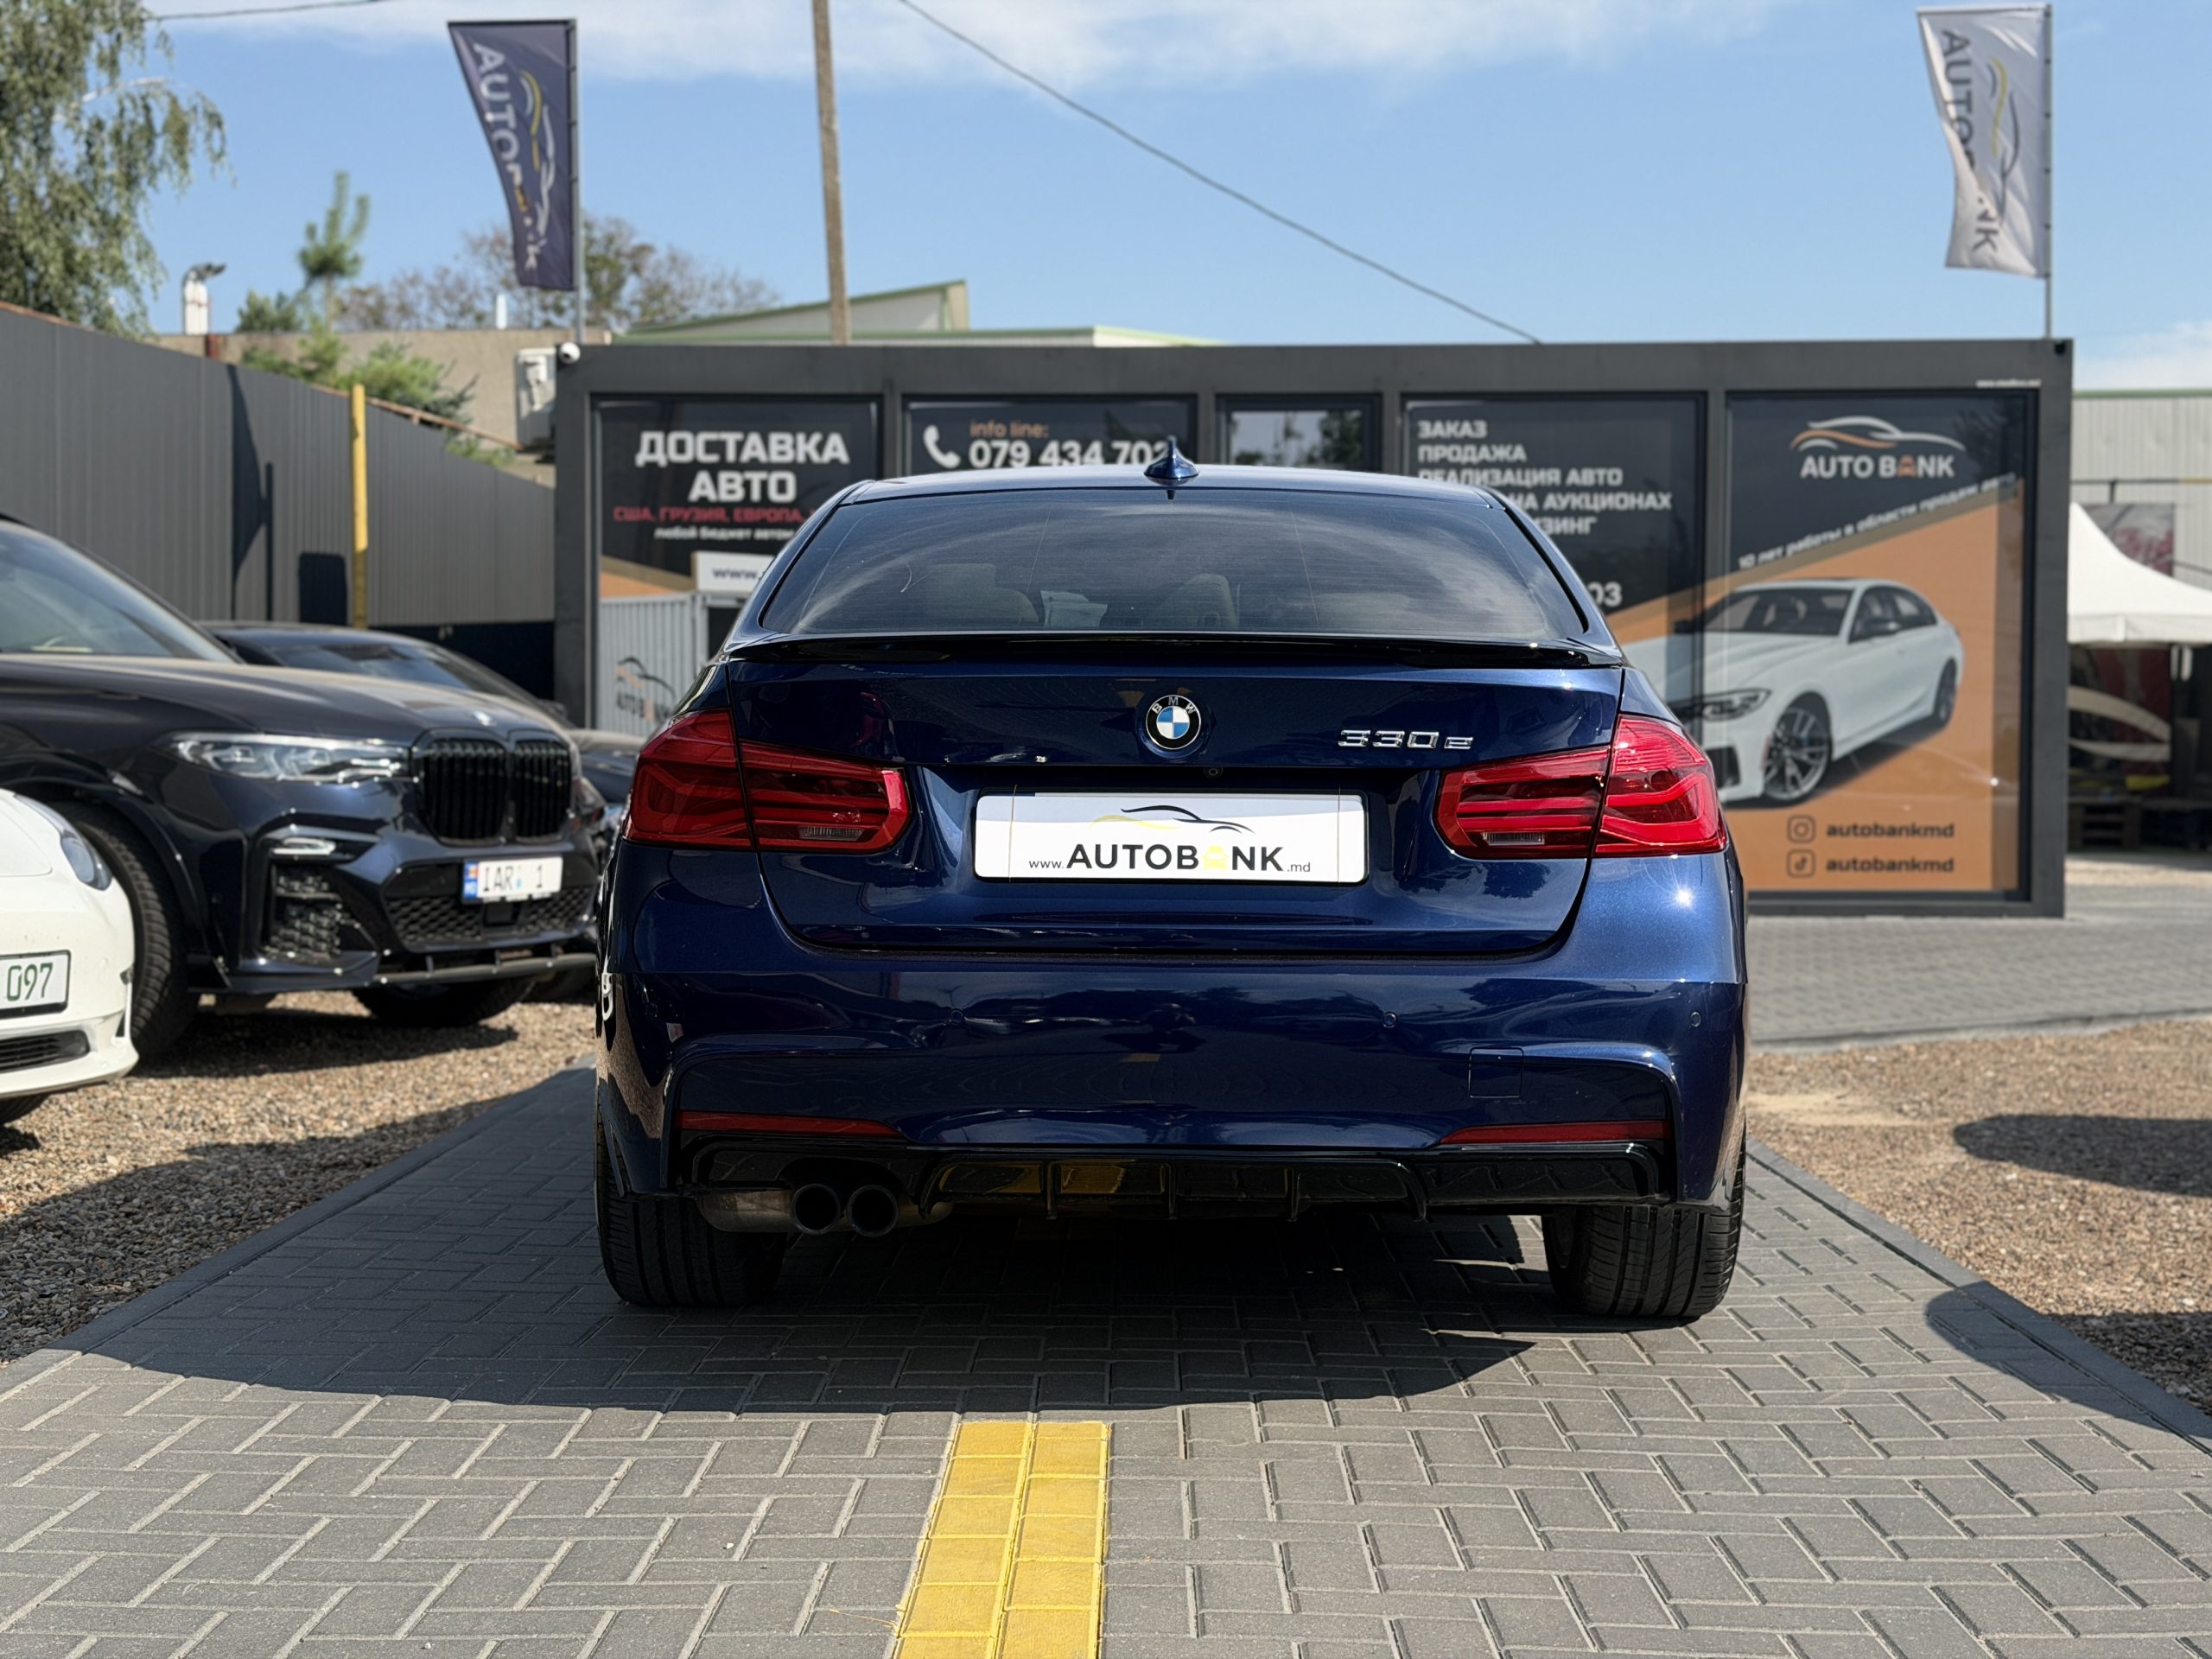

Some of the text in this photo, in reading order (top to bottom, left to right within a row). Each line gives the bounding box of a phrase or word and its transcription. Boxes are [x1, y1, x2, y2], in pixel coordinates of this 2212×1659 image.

[970, 421, 1049, 438] info line:
[1418, 421, 1487, 439] ЗАКАЗ
[635, 431, 849, 467] ДОСТАВКА
[969, 439, 1031, 468] 079
[1039, 440, 1104, 467] 434
[1418, 445, 1527, 463] ПРОДАЖА
[1801, 455, 1874, 479] AUTO
[688, 471, 797, 502] АВТО
[1566, 468, 1623, 486] АВТО
[1543, 493, 1672, 513] АУКЦИОНАХ
[1152, 696, 1197, 715] BMW
[1826, 823, 1955, 838] autobankmd
[1826, 856, 1955, 873] autobankmd
[6, 962, 54, 1001] 097
